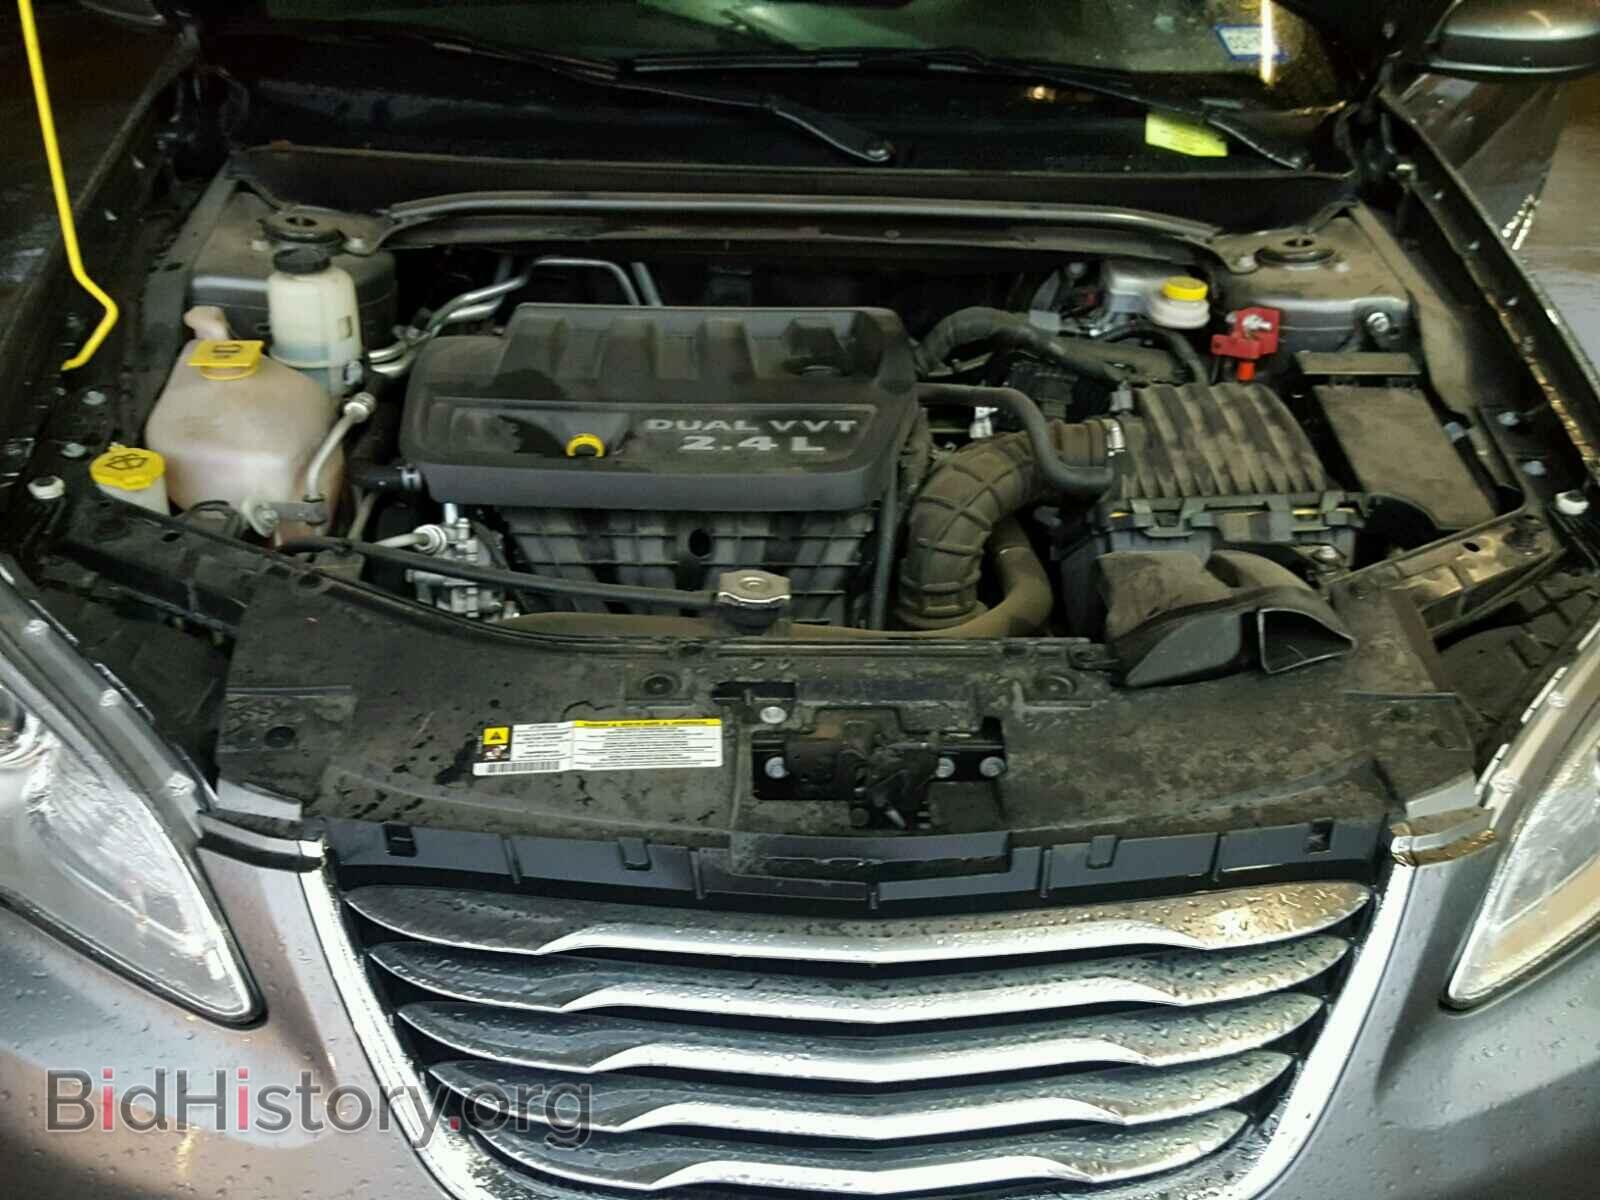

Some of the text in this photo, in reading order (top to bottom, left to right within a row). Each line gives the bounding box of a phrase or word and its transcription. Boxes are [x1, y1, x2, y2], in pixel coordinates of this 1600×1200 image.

[645, 418, 858, 432] DUAL VVT
[679, 435, 779, 451] 2.4
